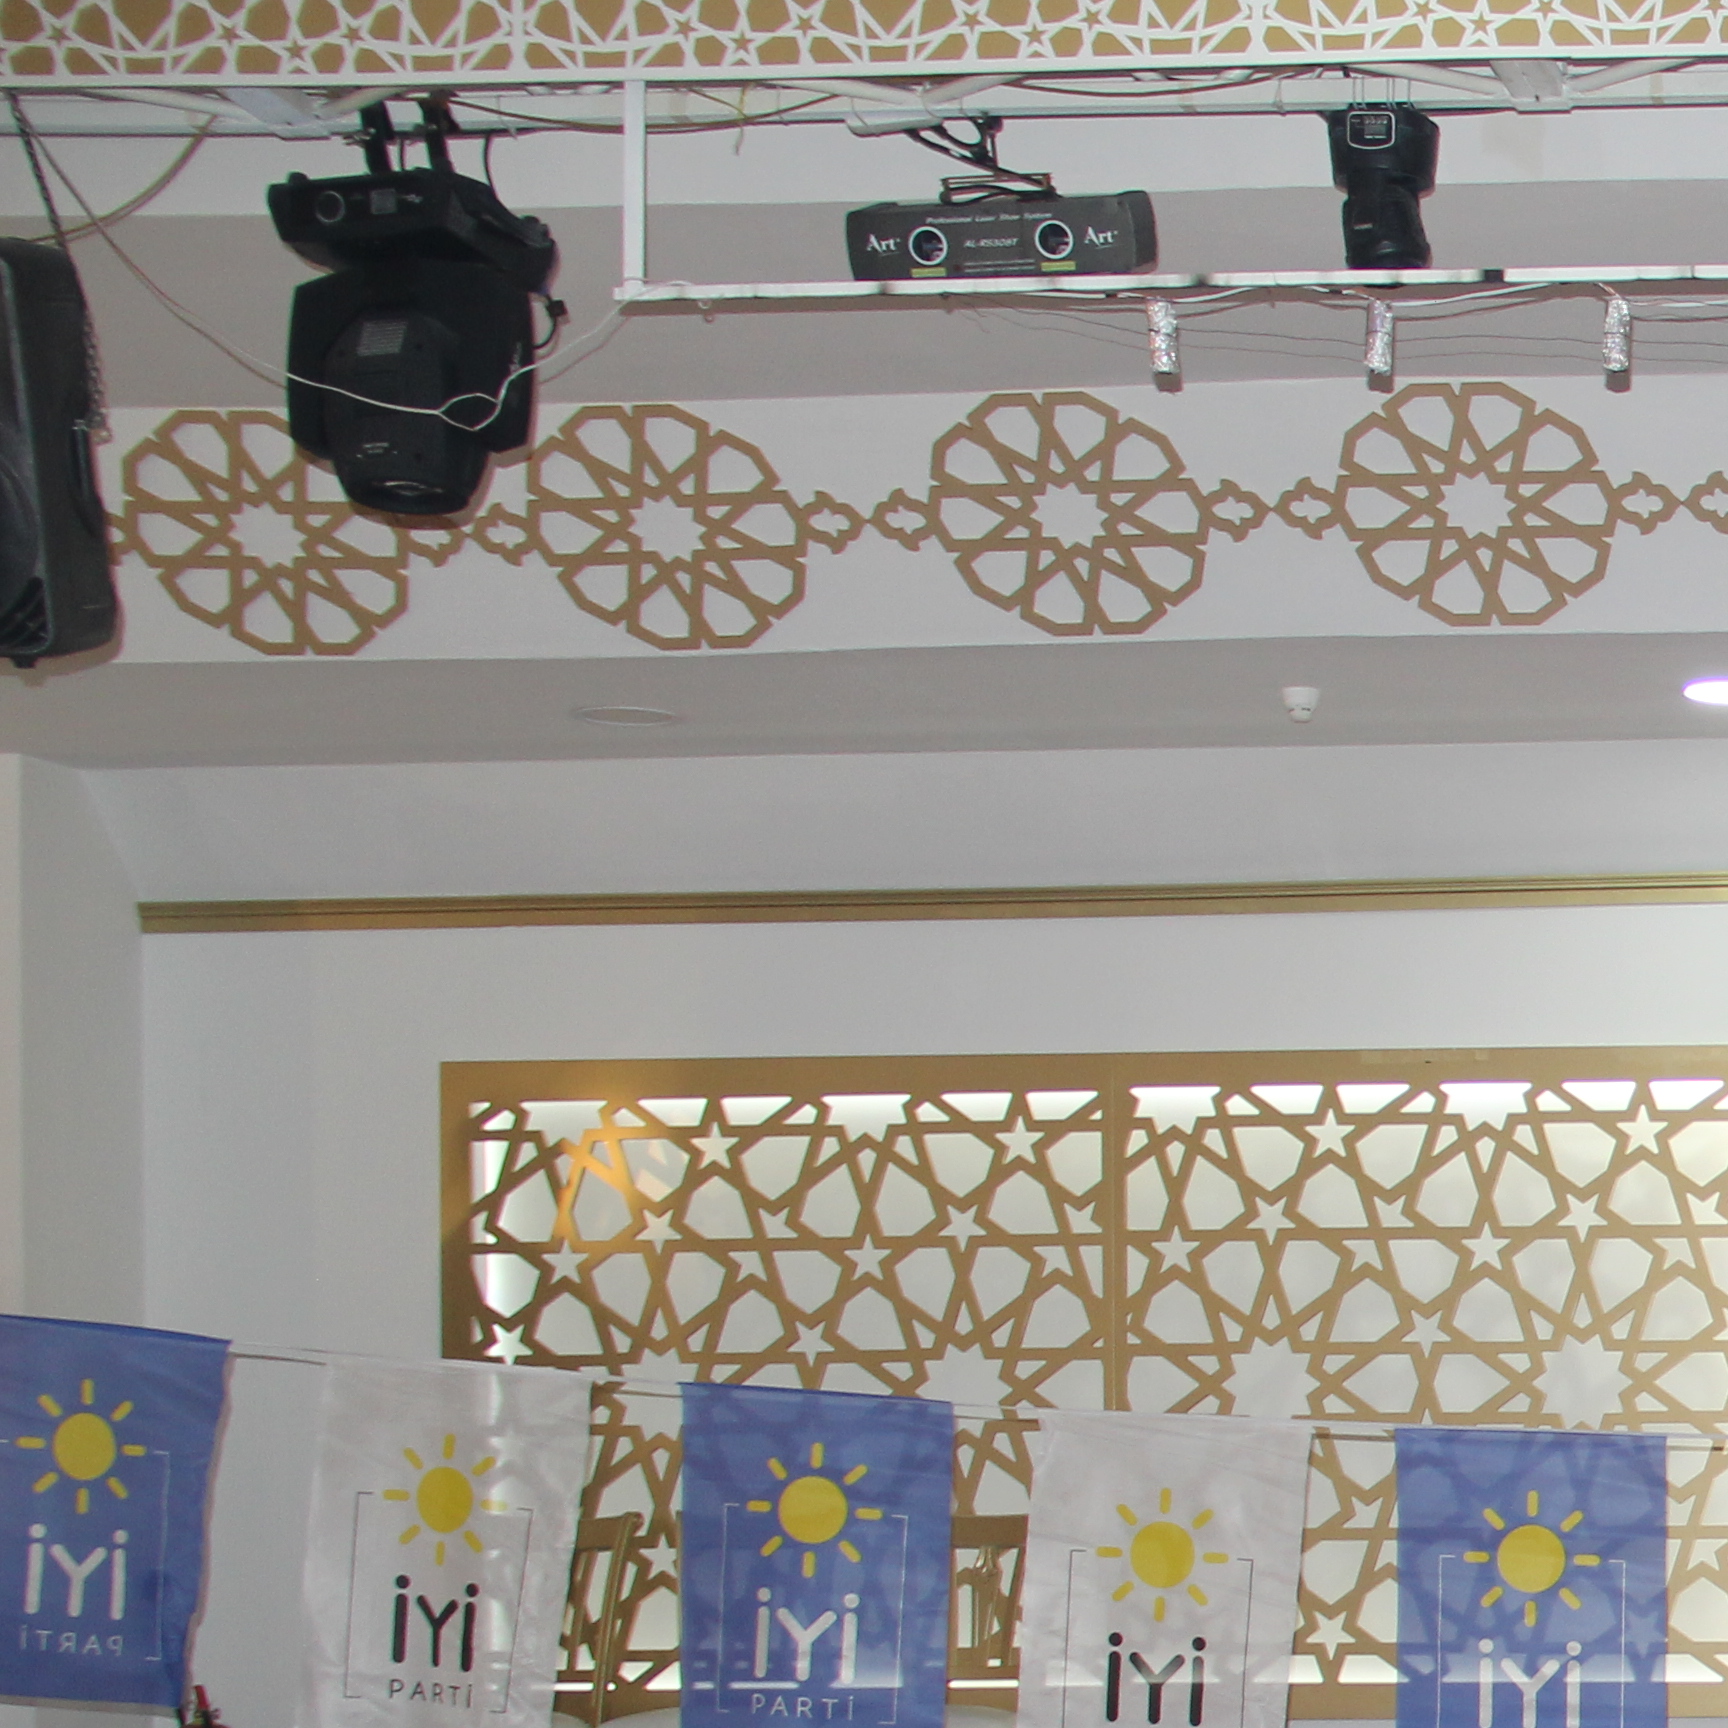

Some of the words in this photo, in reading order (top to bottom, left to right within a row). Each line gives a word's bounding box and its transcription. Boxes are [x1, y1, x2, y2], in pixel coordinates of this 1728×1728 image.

[866, 234, 897, 253] Art
[1084, 226, 1113, 246] Art
[388, 1677, 474, 1709] PARTİ
[750, 1692, 854, 1722] PARTİ
